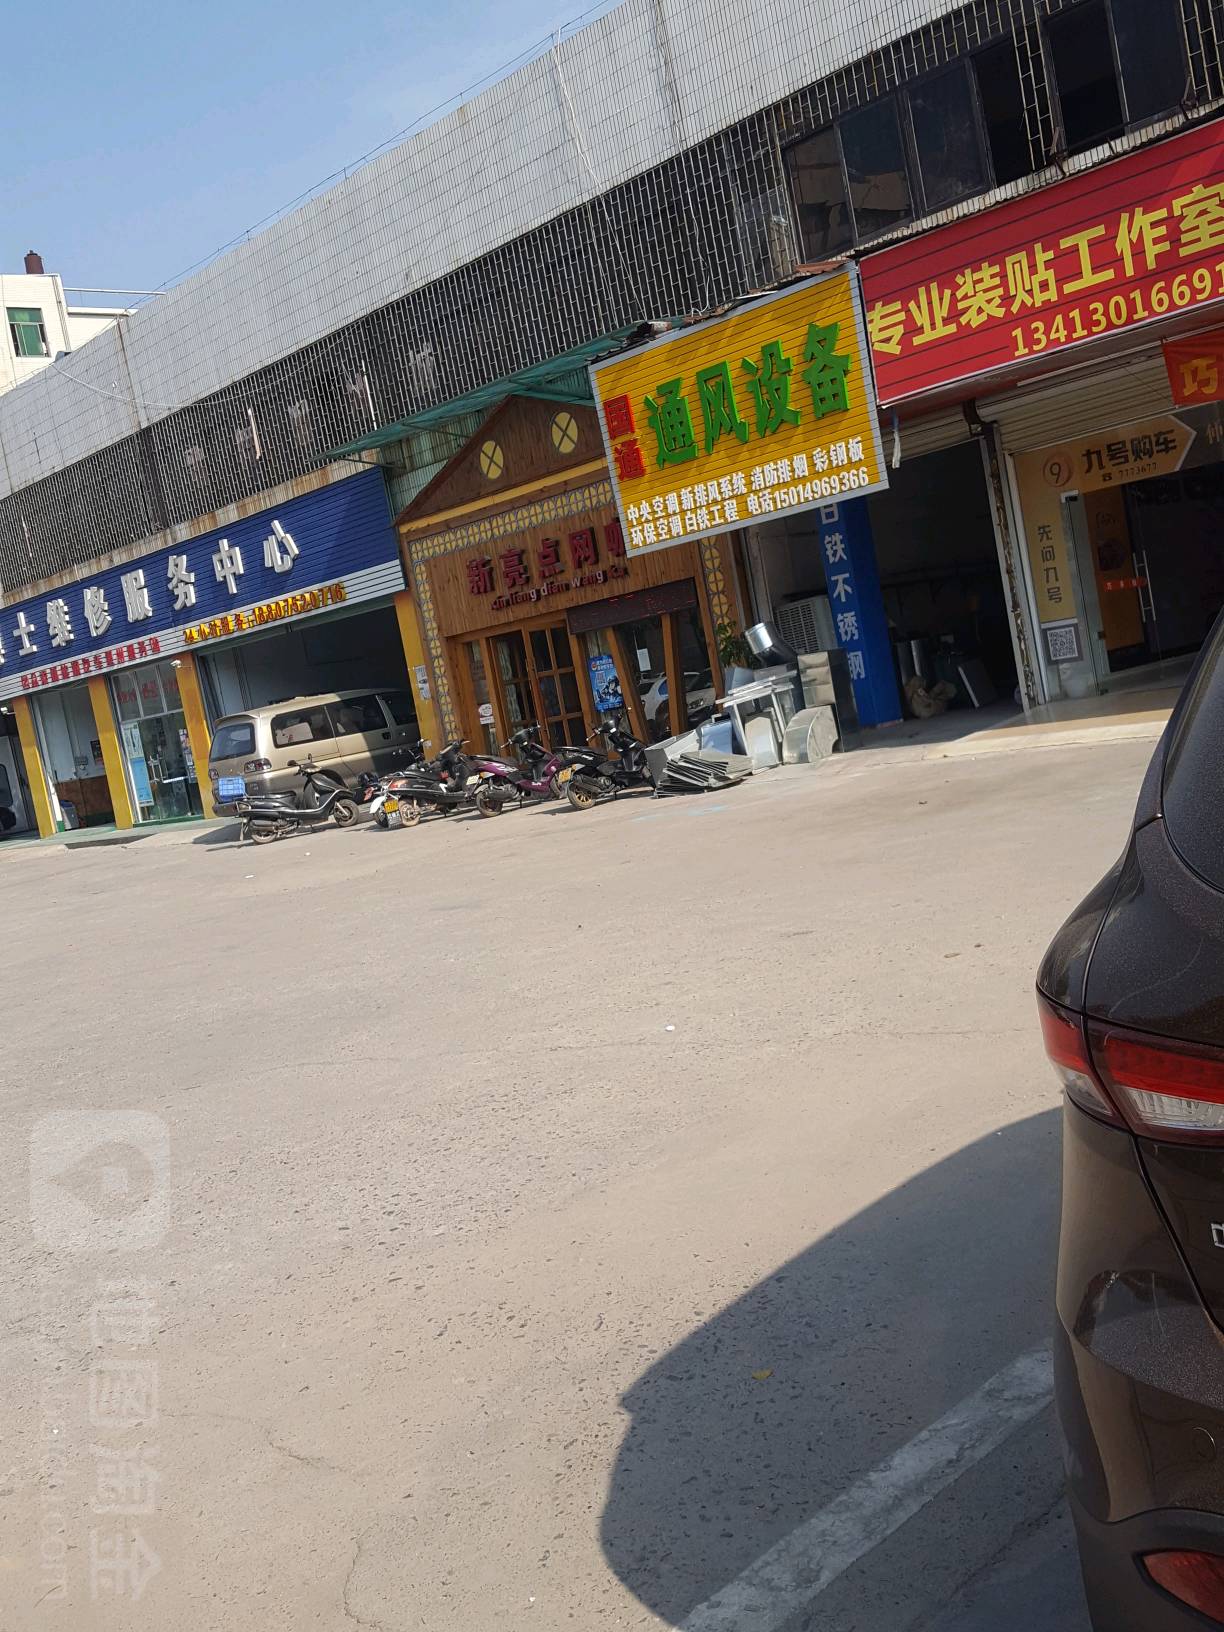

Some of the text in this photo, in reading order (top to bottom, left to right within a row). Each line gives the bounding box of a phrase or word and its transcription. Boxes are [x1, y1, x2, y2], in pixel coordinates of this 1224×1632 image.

[867, 183, 1224, 355] 专业装贴工作室
[644, 322, 851, 470] 通风设备
[627, 436, 864, 525] 中央空调 新排风系统 消防排烟 彩钢板
[1081, 429, 1177, 474] 九号购车
[630, 467, 869, 547] 环保空调 白铁工程 电话15014969366
[0, 519, 299, 664] 士维修服务中心
[1037, 524, 1062, 604] 先问九号
